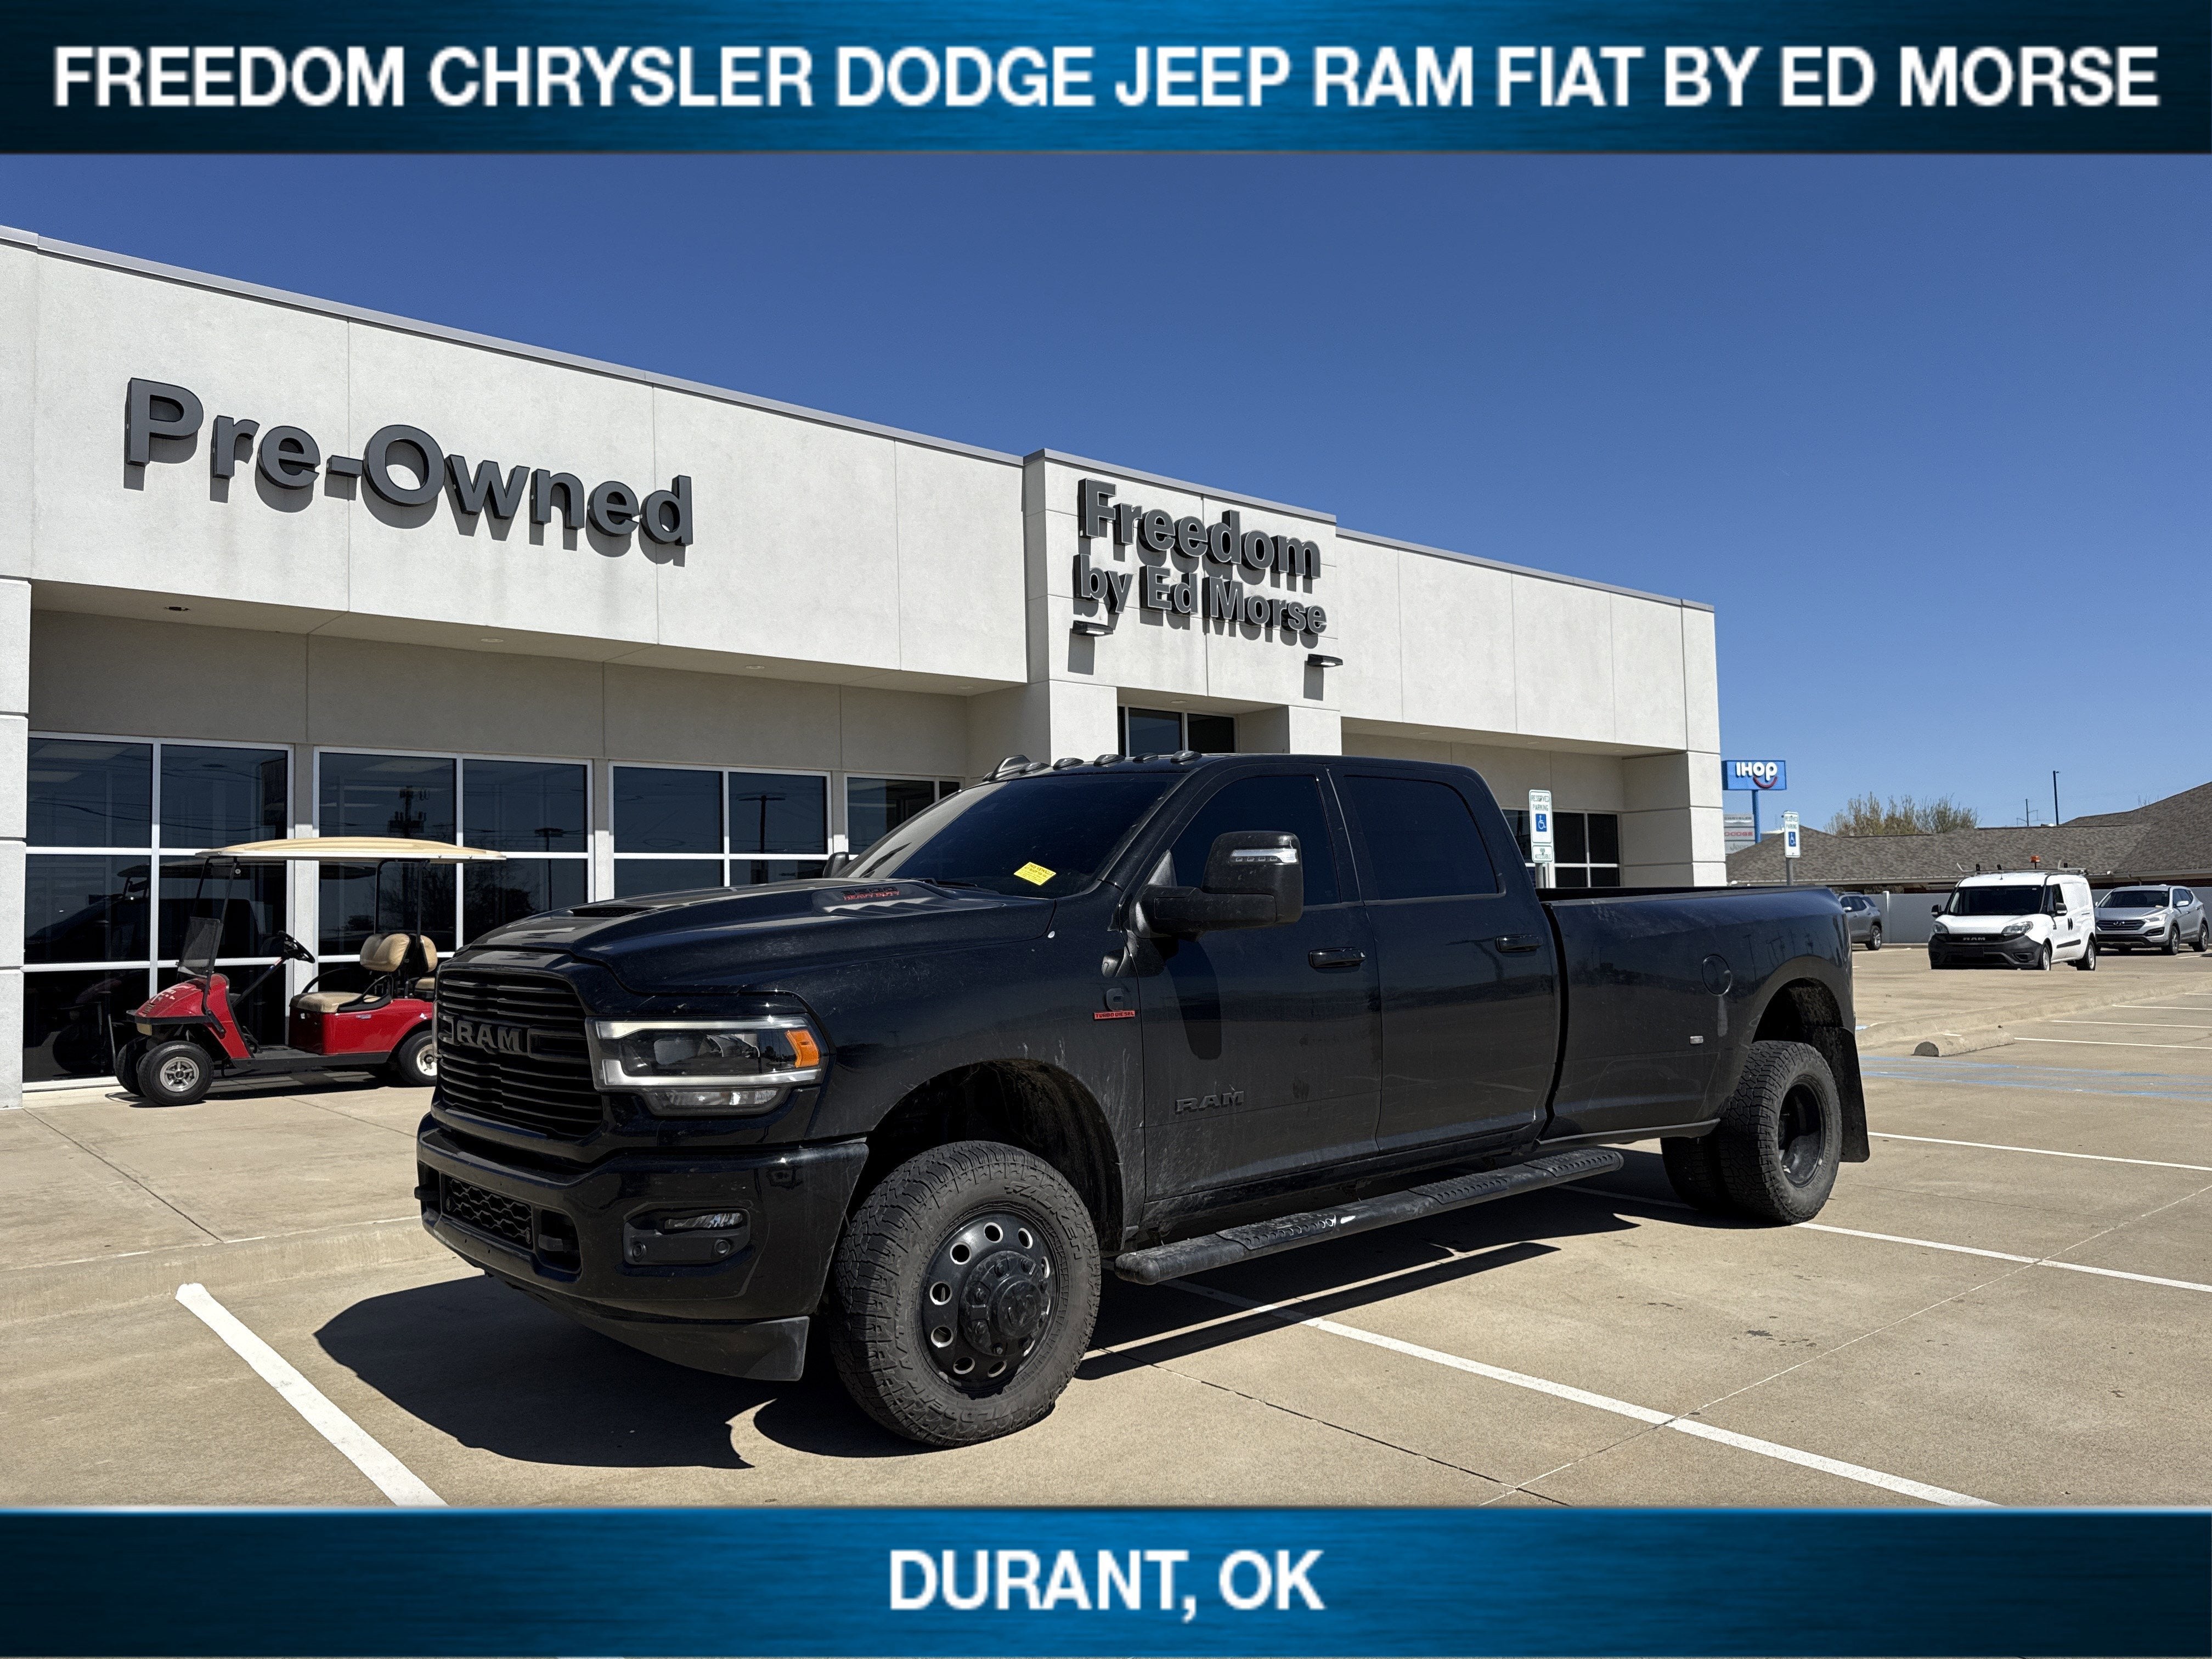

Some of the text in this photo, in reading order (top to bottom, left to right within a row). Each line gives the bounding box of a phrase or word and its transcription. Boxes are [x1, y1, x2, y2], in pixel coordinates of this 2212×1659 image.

[124, 377, 693, 547] Pre-Owned
[1078, 478, 1322, 579] Freedom
[1073, 554, 1327, 634] by Ed Morse
[1531, 794, 1550, 803] RESERVED
[1735, 761, 1778, 782] IHOP
[456, 1019, 524, 1054] RAM
[1175, 1091, 1244, 1113] RAM
[1004, 1181, 1083, 1261] FALKEN
